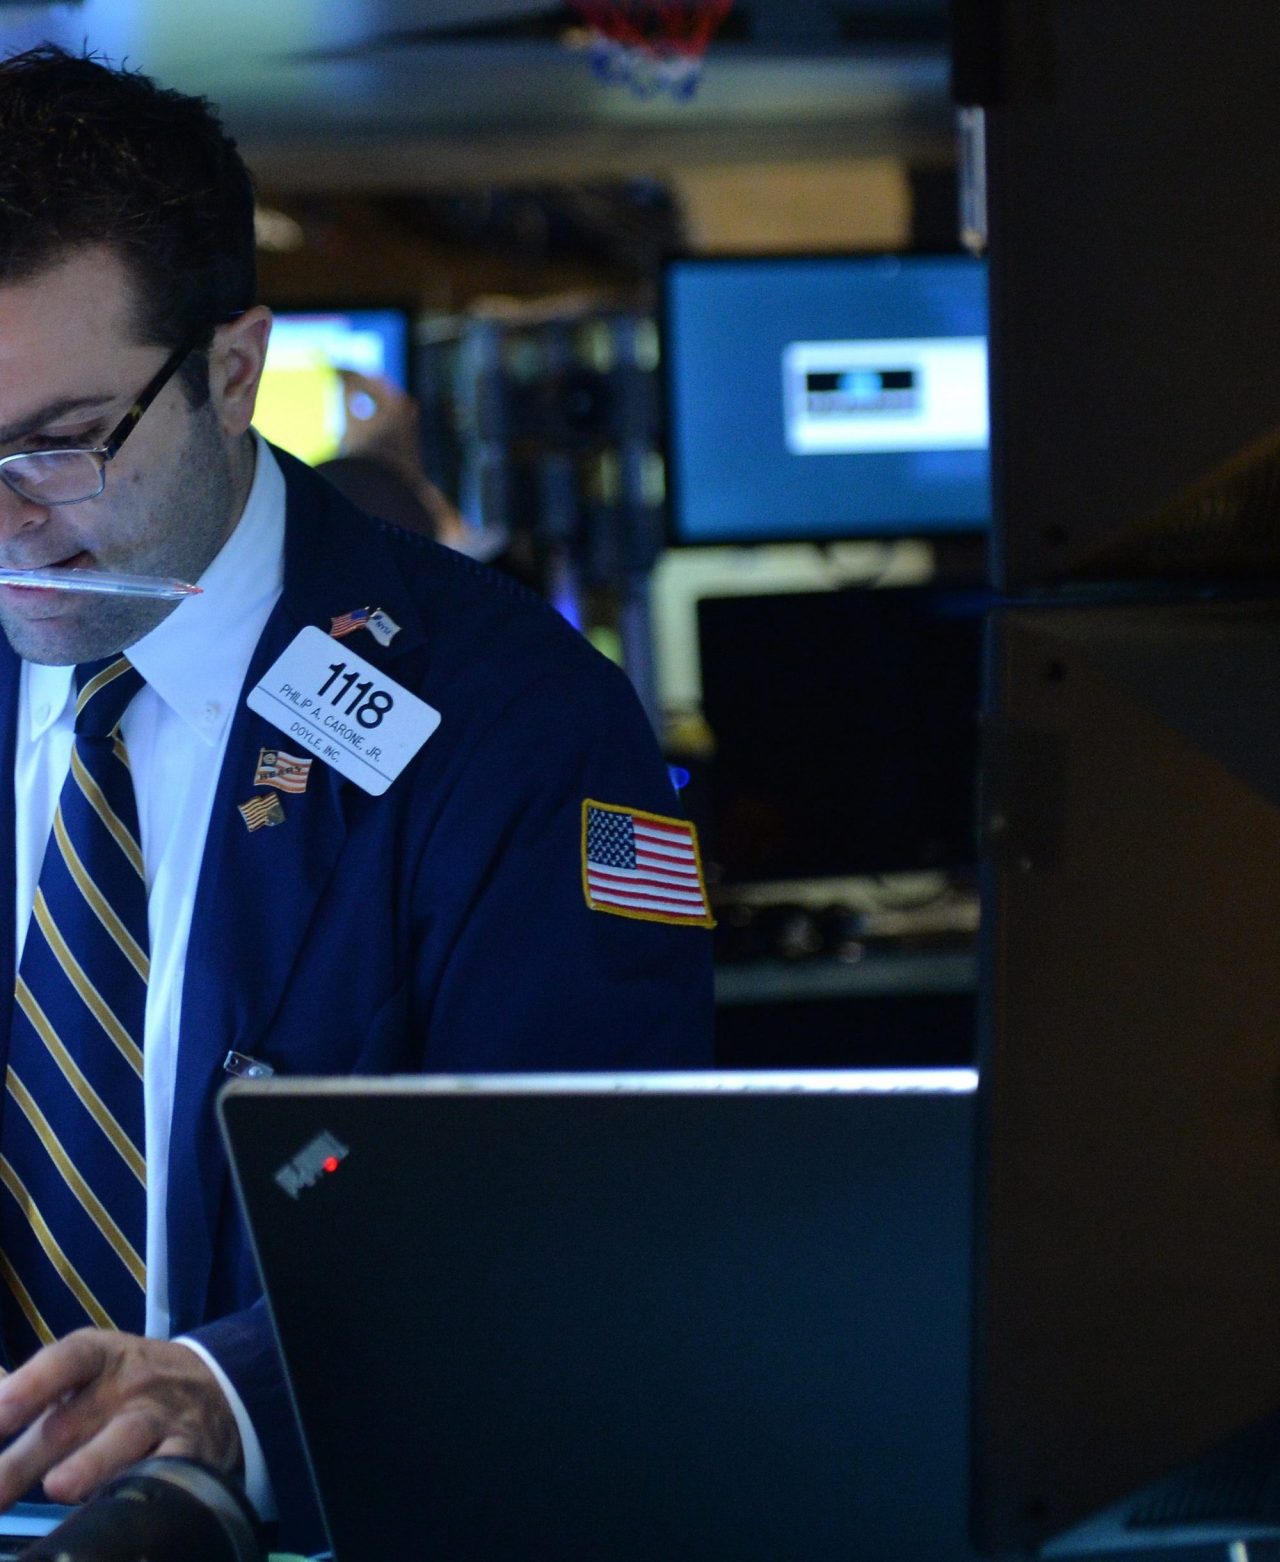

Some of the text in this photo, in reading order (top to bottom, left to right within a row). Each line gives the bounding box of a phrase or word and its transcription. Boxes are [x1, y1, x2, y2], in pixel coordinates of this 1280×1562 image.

[279, 683, 382, 762] PHILIP A. CARONE, JR.
[317, 662, 394, 729] 1118
[289, 721, 340, 763] DOYLE, INC.
